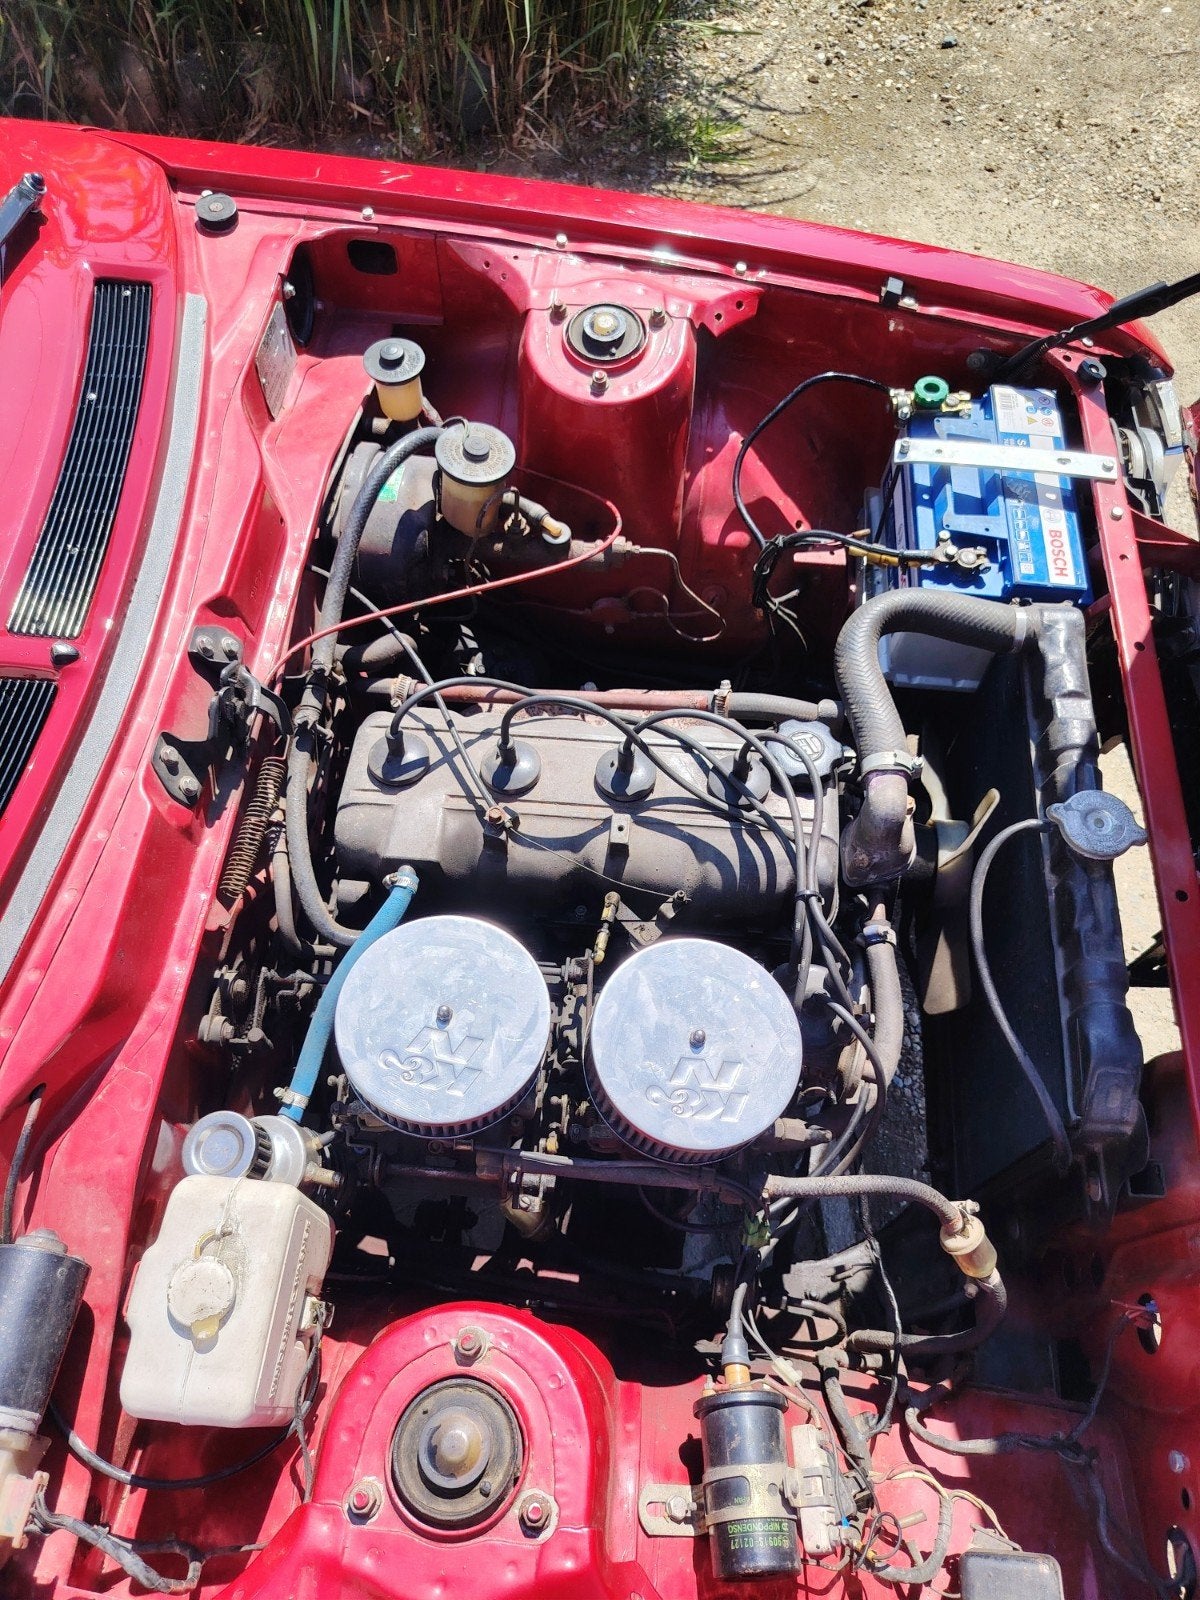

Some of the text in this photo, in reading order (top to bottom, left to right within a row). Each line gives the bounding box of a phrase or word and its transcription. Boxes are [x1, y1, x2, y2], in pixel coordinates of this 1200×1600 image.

[1049, 529, 1069, 578] BOSCH
[379, 1025, 484, 1098] K&N
[645, 1056, 750, 1123] K&N
[728, 1523, 780, 1533] NIPPONDENSO
